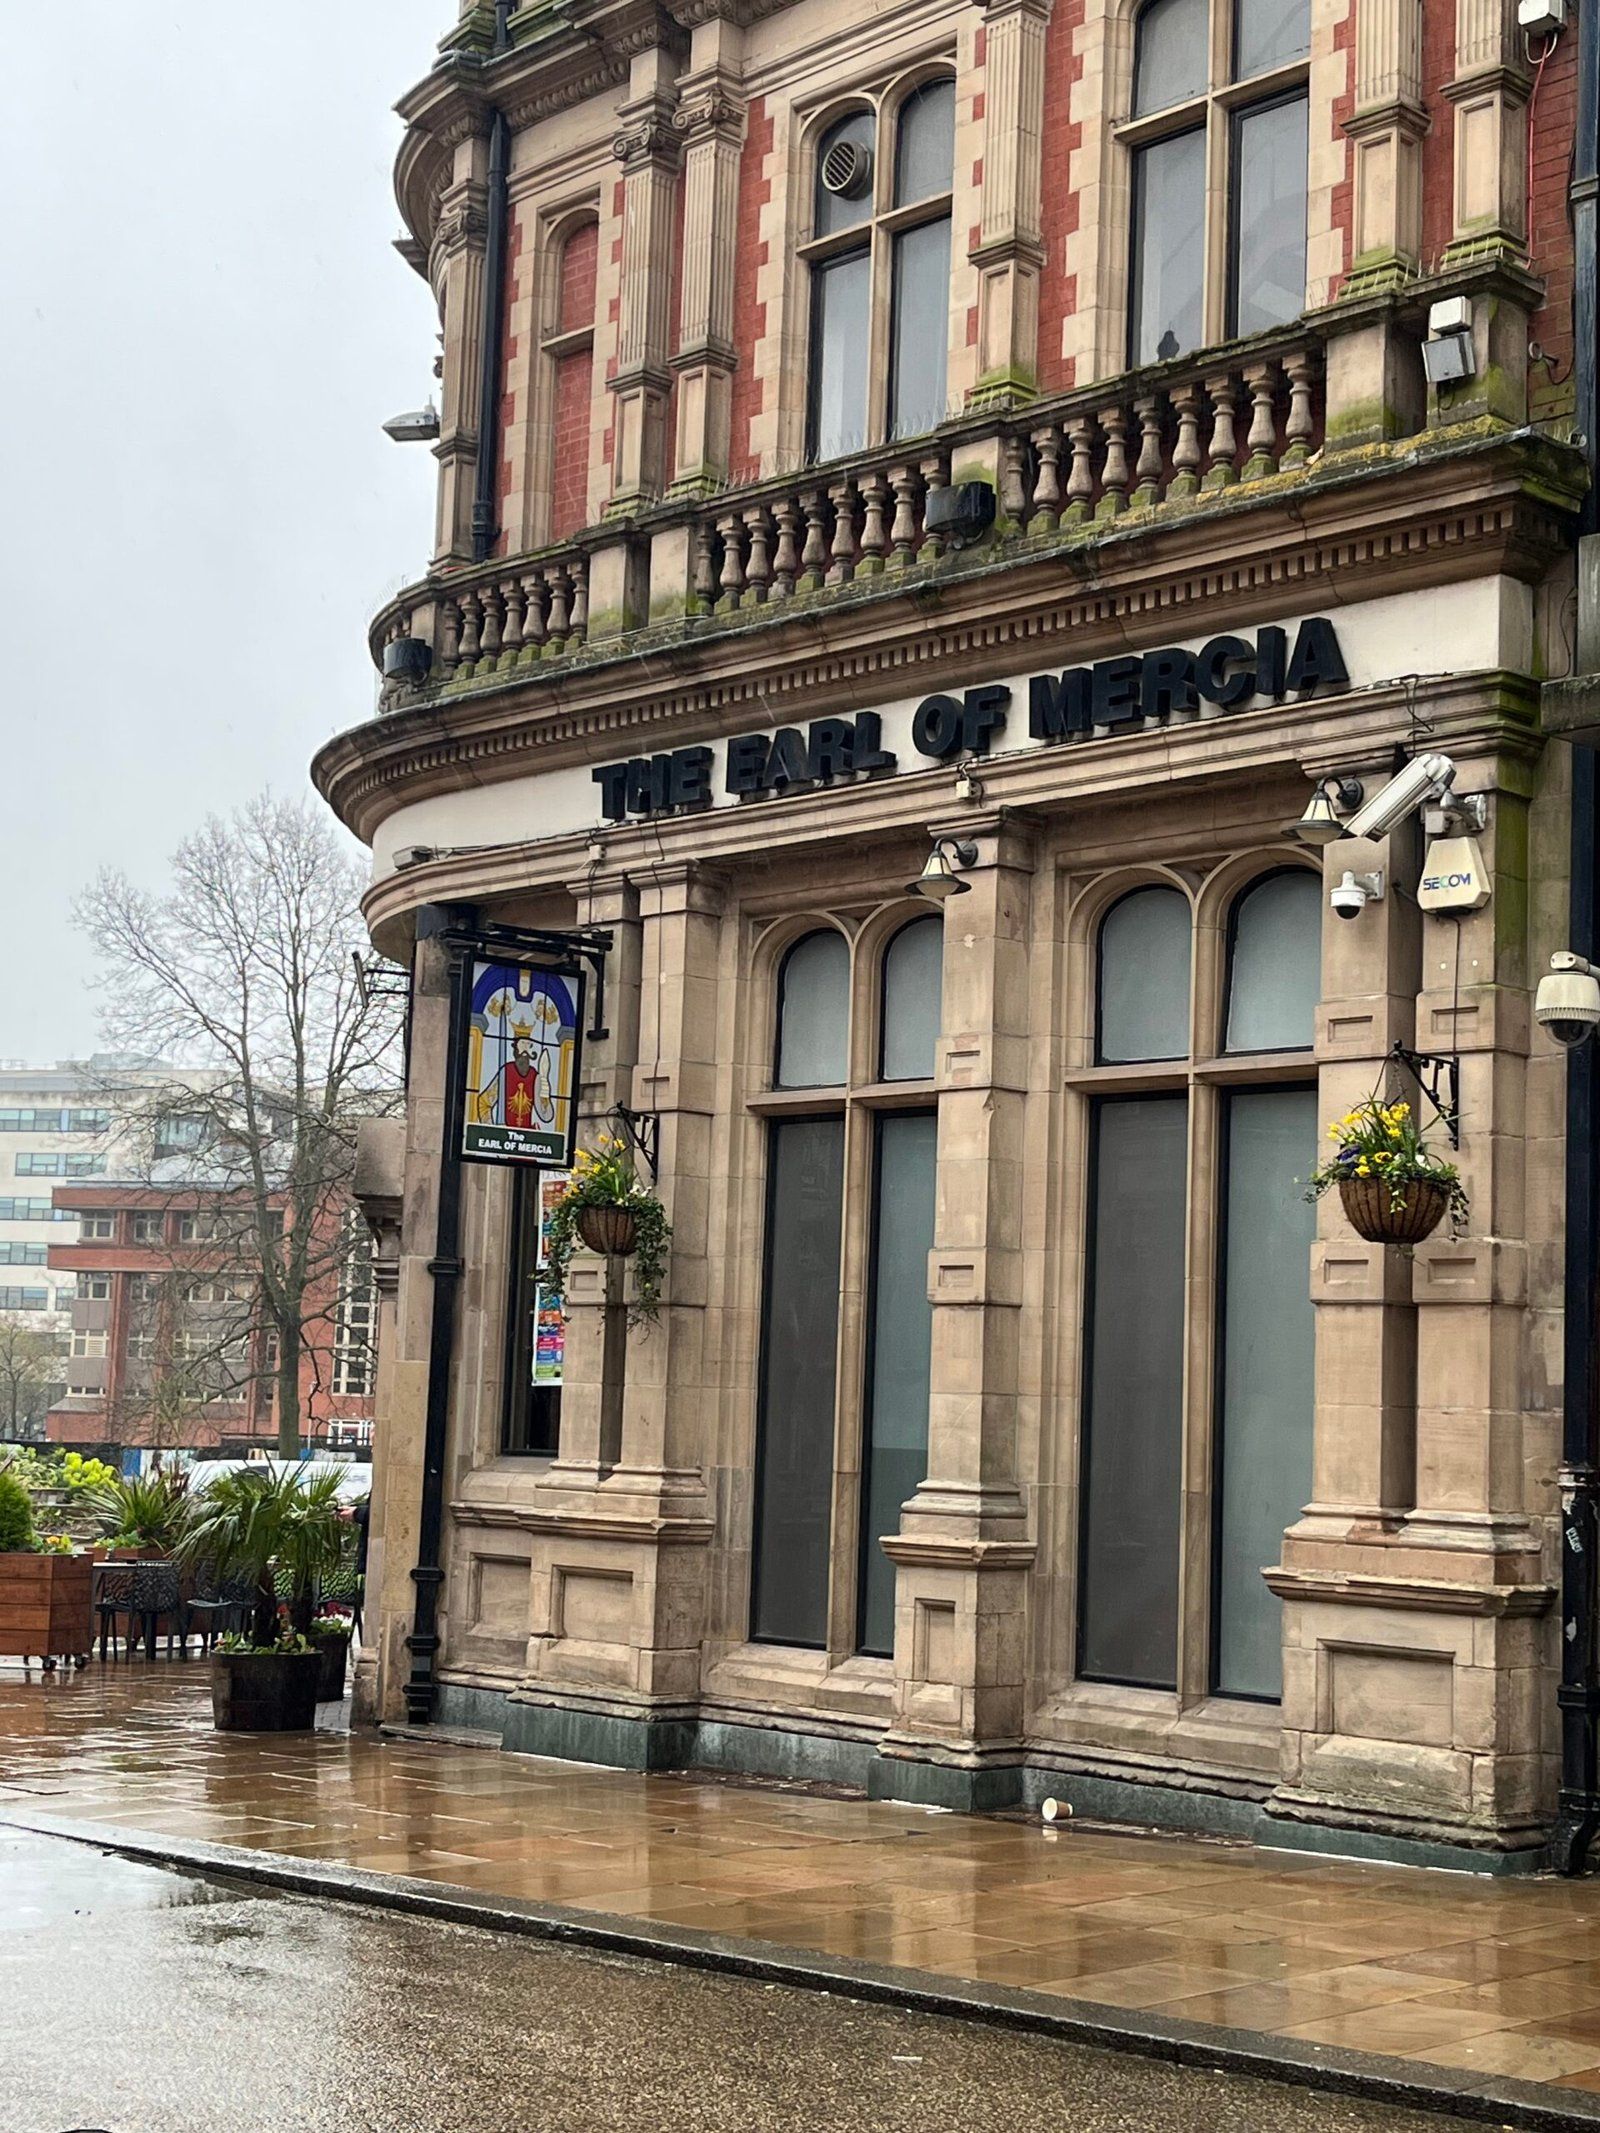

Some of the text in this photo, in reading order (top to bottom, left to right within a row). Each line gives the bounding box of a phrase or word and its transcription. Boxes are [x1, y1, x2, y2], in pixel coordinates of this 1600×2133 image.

[592, 617, 1350, 819] THE EARL OF MERCIA
[1423, 873, 1471, 891] SECOM
[508, 1131, 525, 1142] The
[478, 1138, 552, 1155] EARL OF MERCIA
